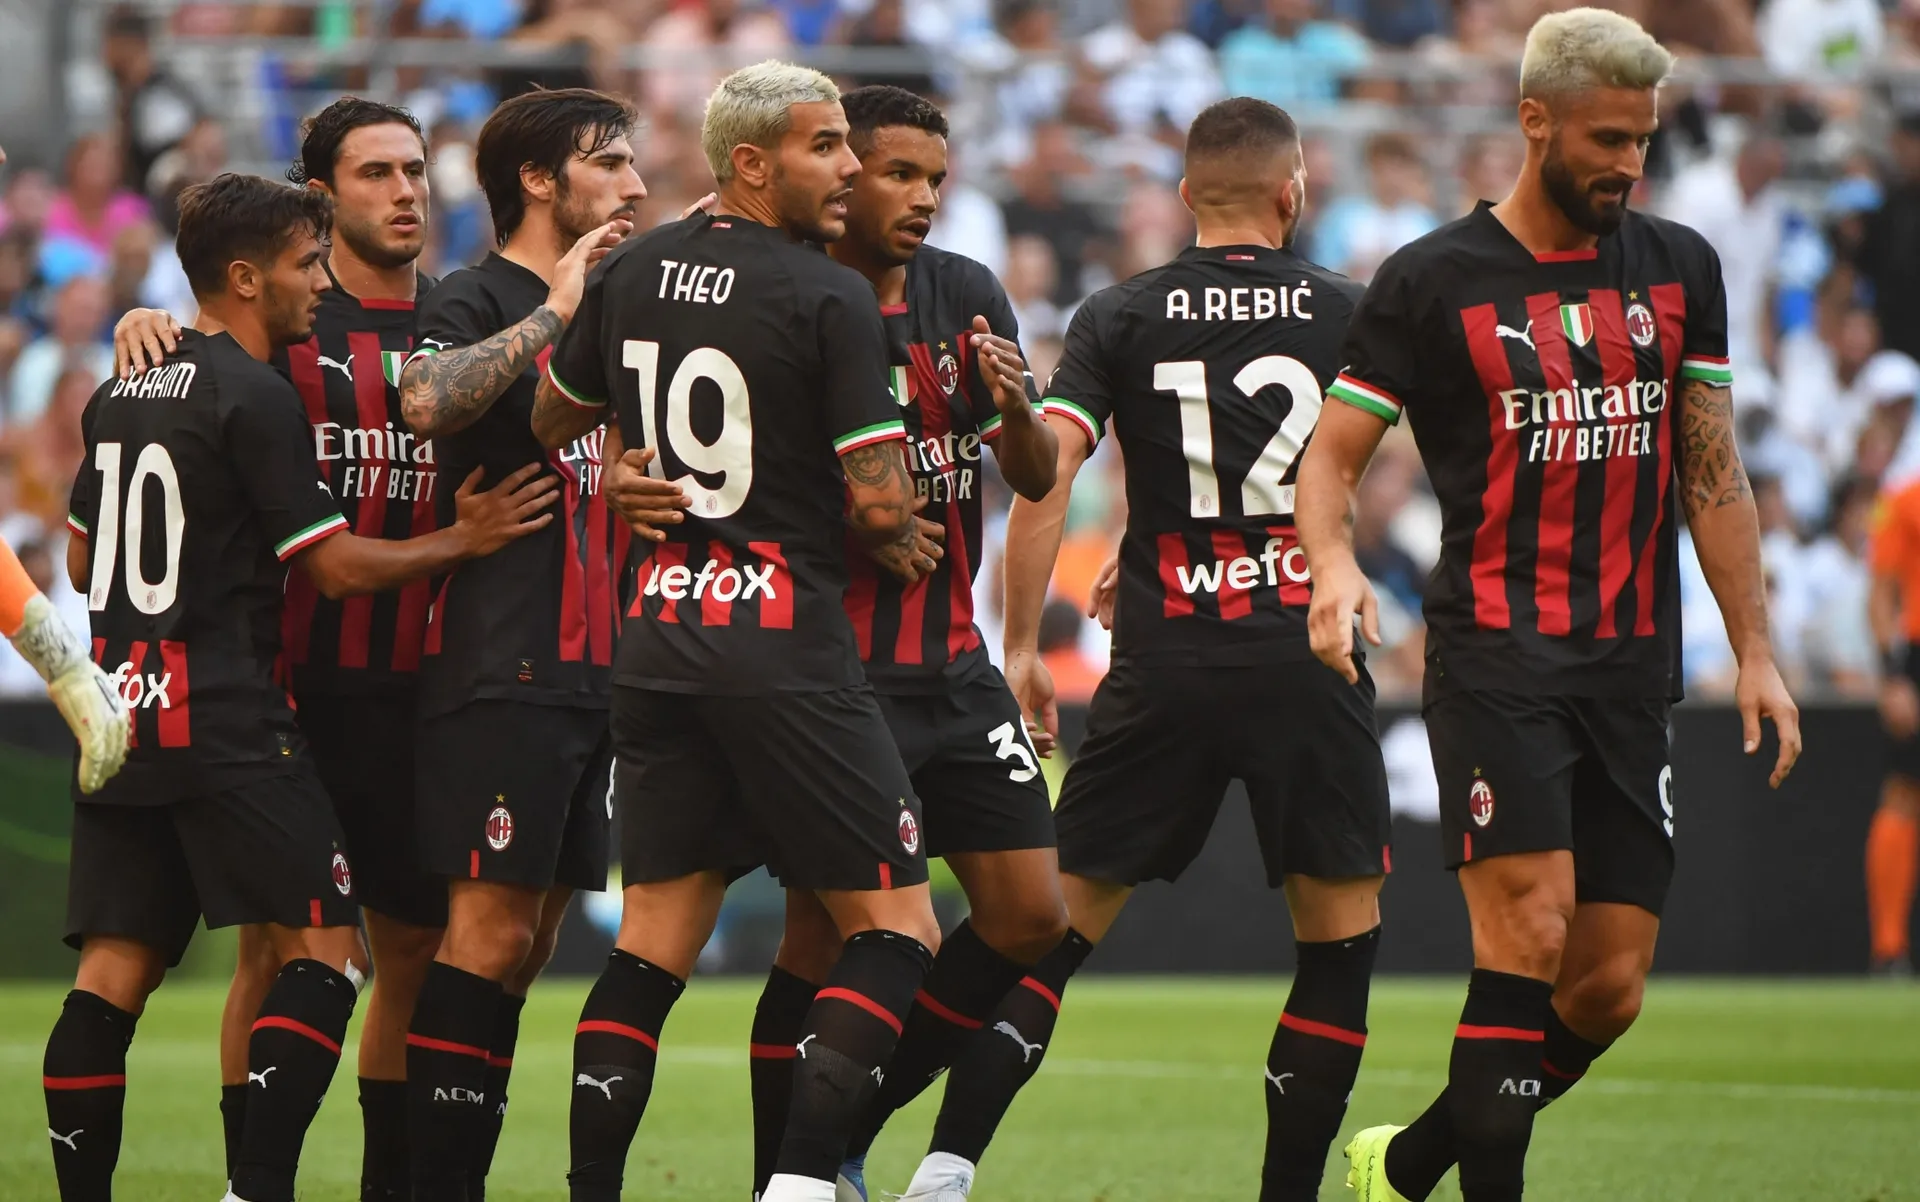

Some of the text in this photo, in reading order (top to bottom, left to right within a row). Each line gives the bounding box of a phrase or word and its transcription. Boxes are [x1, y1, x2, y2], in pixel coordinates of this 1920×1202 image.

[659, 260, 735, 304] THEO
[1166, 280, 1313, 320] A.REBIĆ
[1498, 376, 1669, 430] Emirates
[622, 340, 753, 518] 19
[1154, 355, 1324, 517] 12
[1528, 421, 1651, 462] FLY BETTER
[342, 466, 382, 497] FLY
[579, 464, 603, 496] FLY
[88, 443, 186, 615] 10
[987, 714, 1039, 783] 3
[433, 1086, 485, 1105] ACM
